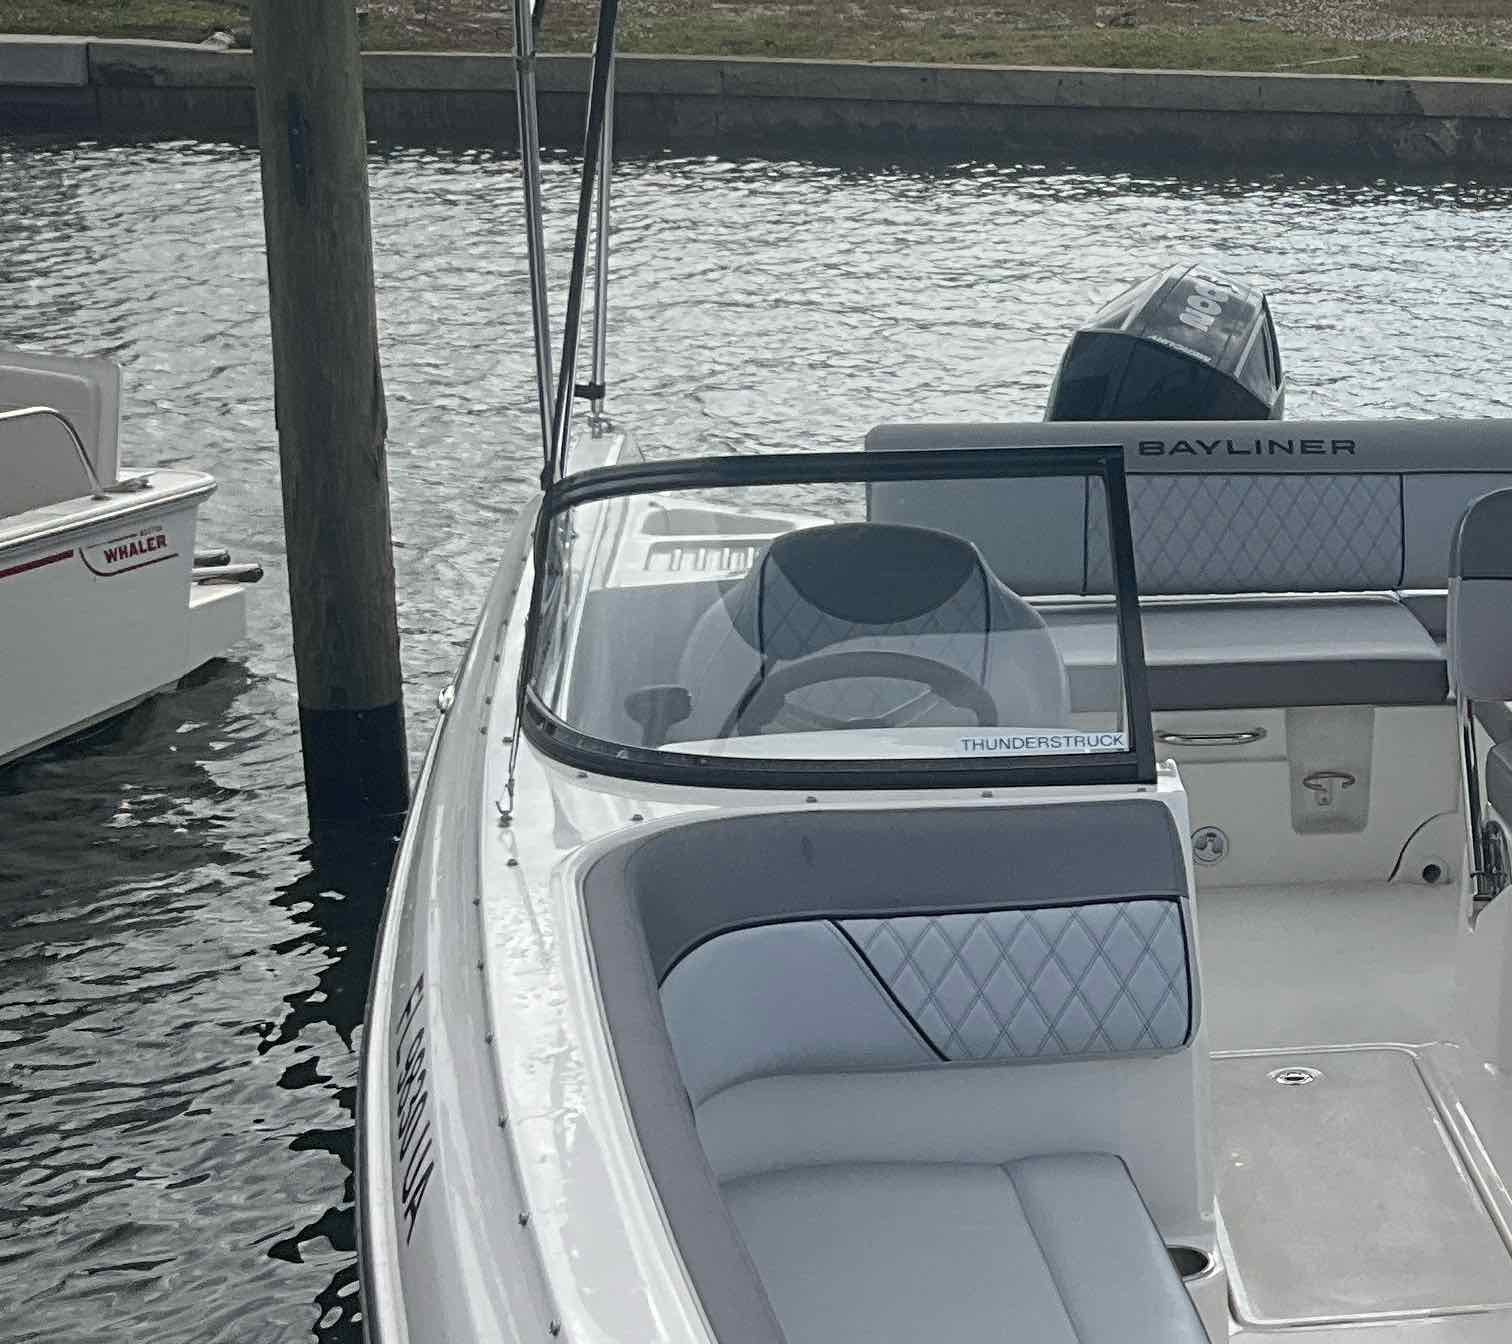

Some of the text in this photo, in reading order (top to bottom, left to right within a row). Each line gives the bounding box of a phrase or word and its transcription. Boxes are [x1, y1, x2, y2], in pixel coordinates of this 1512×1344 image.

[1138, 439, 1357, 456] BAYLINER
[104, 535, 167, 563] WHALER
[961, 734, 1124, 751] THUNDERSTRUCK
[396, 972, 434, 1245] FL 9830 UA
